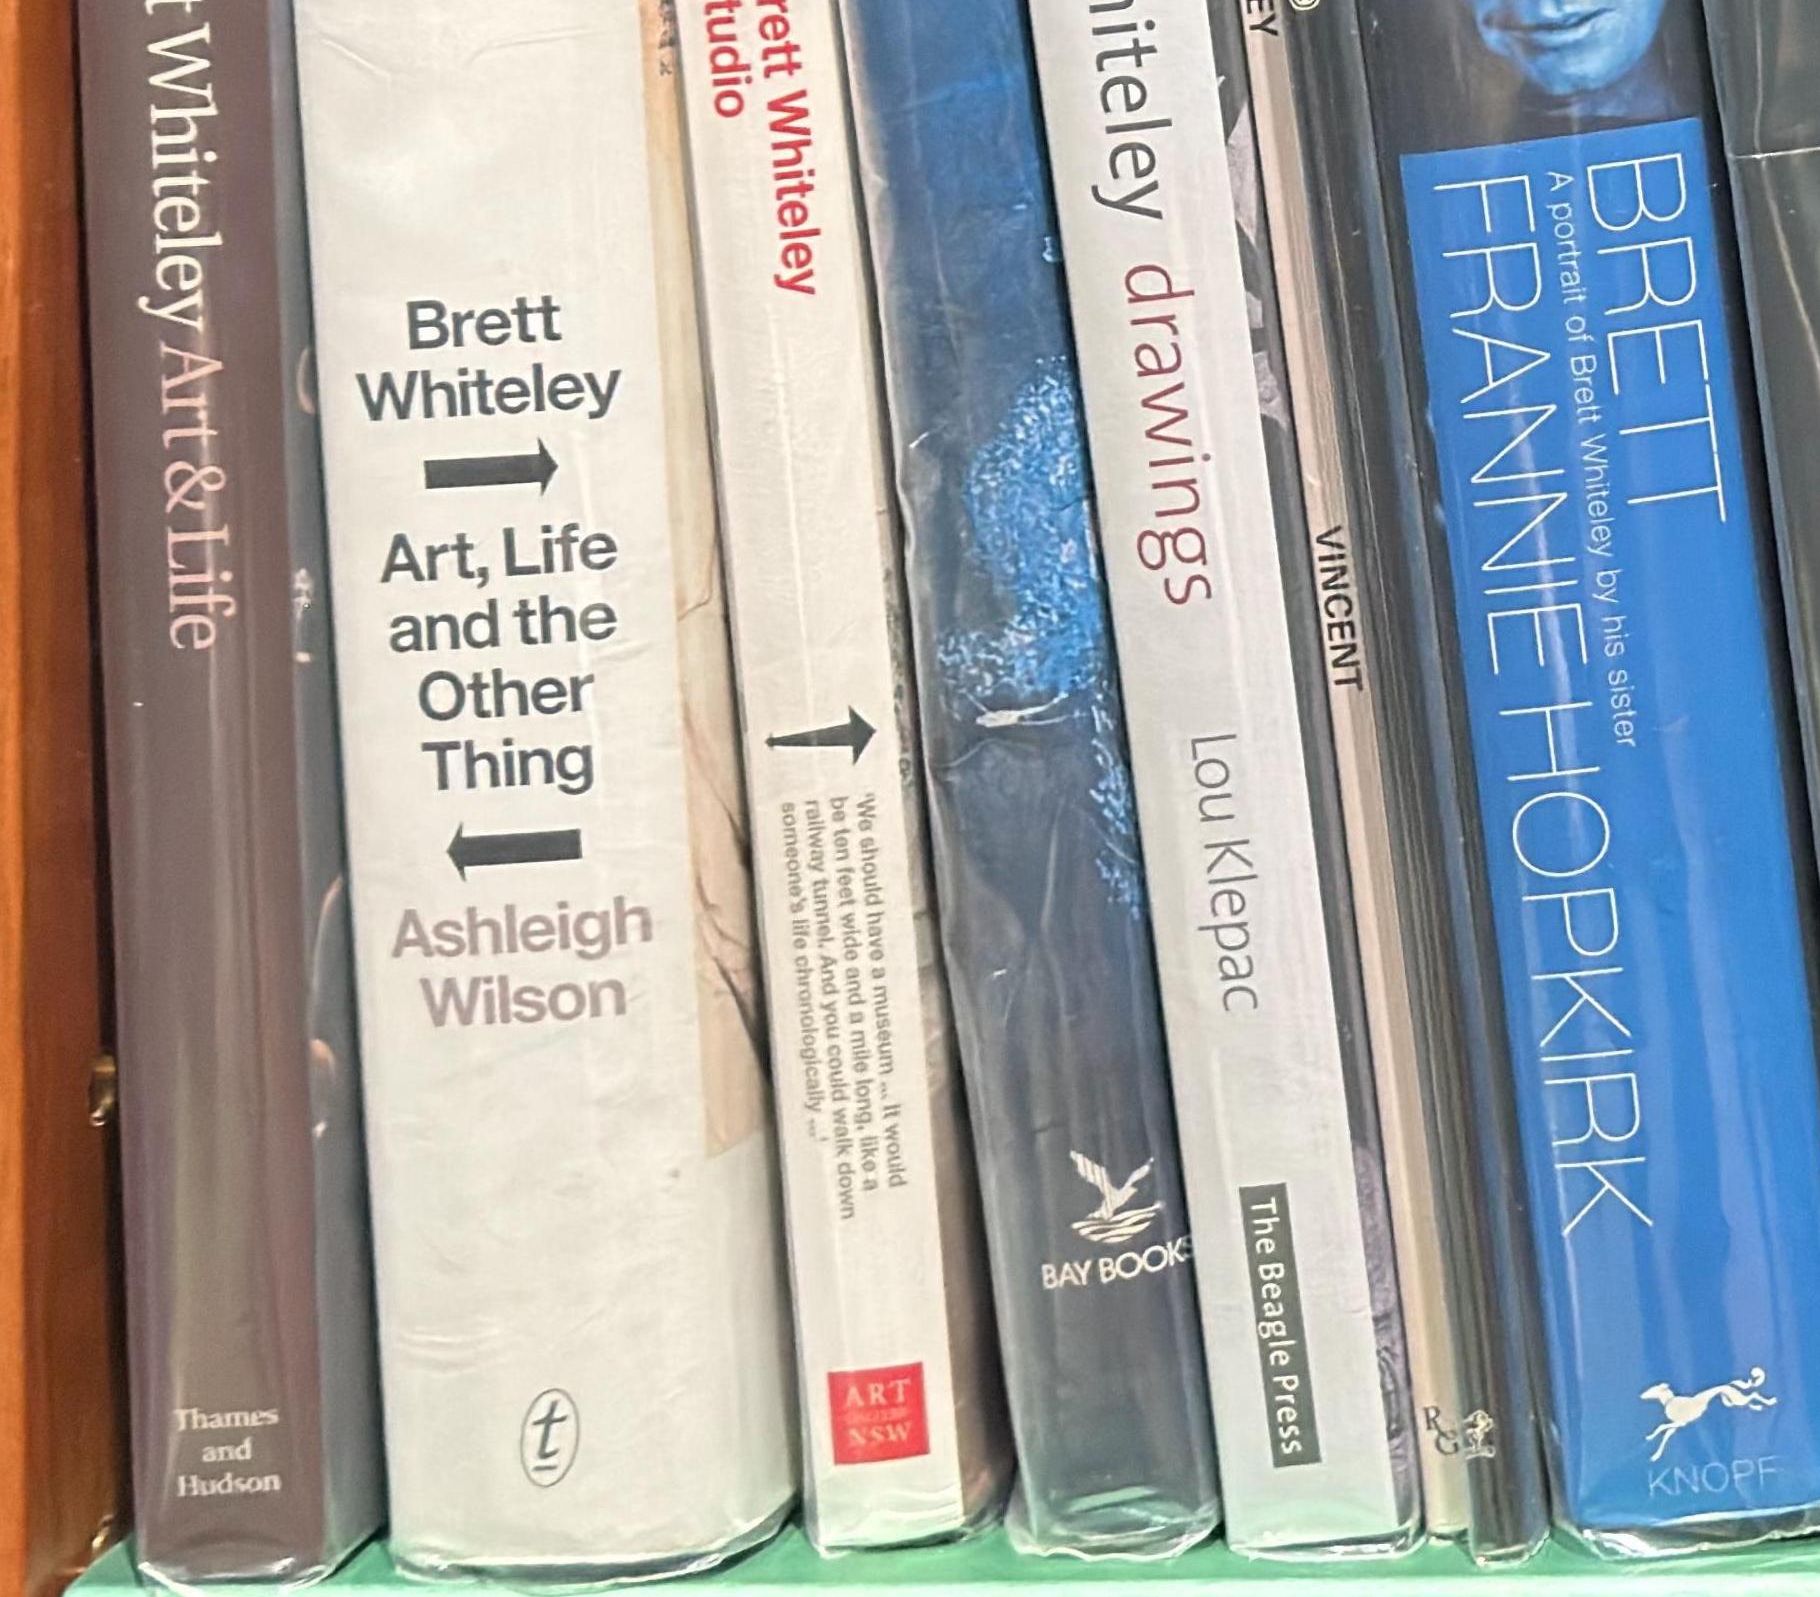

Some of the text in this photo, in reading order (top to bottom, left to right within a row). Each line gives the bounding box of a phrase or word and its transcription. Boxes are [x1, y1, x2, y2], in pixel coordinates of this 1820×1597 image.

[138, 22, 223, 329] Whiteley
[765, 89, 821, 299] Whiteley
[406, 294, 563, 350] Brett
[1588, 151, 1728, 523] BRETT
[158, 339, 224, 447] Art
[355, 364, 622, 423] Whiteley
[1124, 262, 1213, 607] drawings
[1546, 171, 1637, 747] A portrait of Brett Whiteley by his sister
[162, 459, 227, 516] &
[380, 522, 619, 590] Art, Life
[168, 525, 237, 653] Life
[1314, 525, 1364, 693] VINCENT
[388, 594, 619, 654] and the
[417, 669, 595, 724] Other
[1434, 174, 1655, 1238] FRANNIE HOPKIRK
[422, 738, 596, 797] Thing
[830, 795, 849, 822] be
[782, 802, 807, 914] someone's
[834, 828, 851, 861] ten
[859, 836, 884, 906] should
[836, 867, 856, 907] feet
[1190, 733, 1260, 1013] Lou Klepac
[390, 895, 654, 962] Ashleigh
[792, 919, 810, 950] life
[840, 912, 863, 962] wide
[867, 911, 885, 961] have
[846, 966, 867, 1007] and
[871, 966, 886, 979] a
[419, 976, 627, 1029] Wilson
[805, 799, 856, 1220] railway tunnel. And you could walk down
[850, 1011, 864, 1025] a
[873, 985, 894, 1075] museum
[795, 955, 825, 1113] chronologically
[851, 1030, 873, 1073] mile
[882, 1104, 901, 1120] It
[859, 1136, 879, 1173] like
[885, 1124, 908, 1188] would
[862, 1179, 878, 1192] a
[1041, 1259, 1092, 1290] BAY
[1250, 1196, 1302, 1455] The Beagle Press
[172, 1404, 280, 1432] Thames
[845, 1377, 912, 1408] ART
[201, 1437, 252, 1464] and
[848, 1420, 912, 1447] NSW
[176, 1467, 281, 1499] Hudson
[1648, 1458, 1780, 1500] KNOPF
